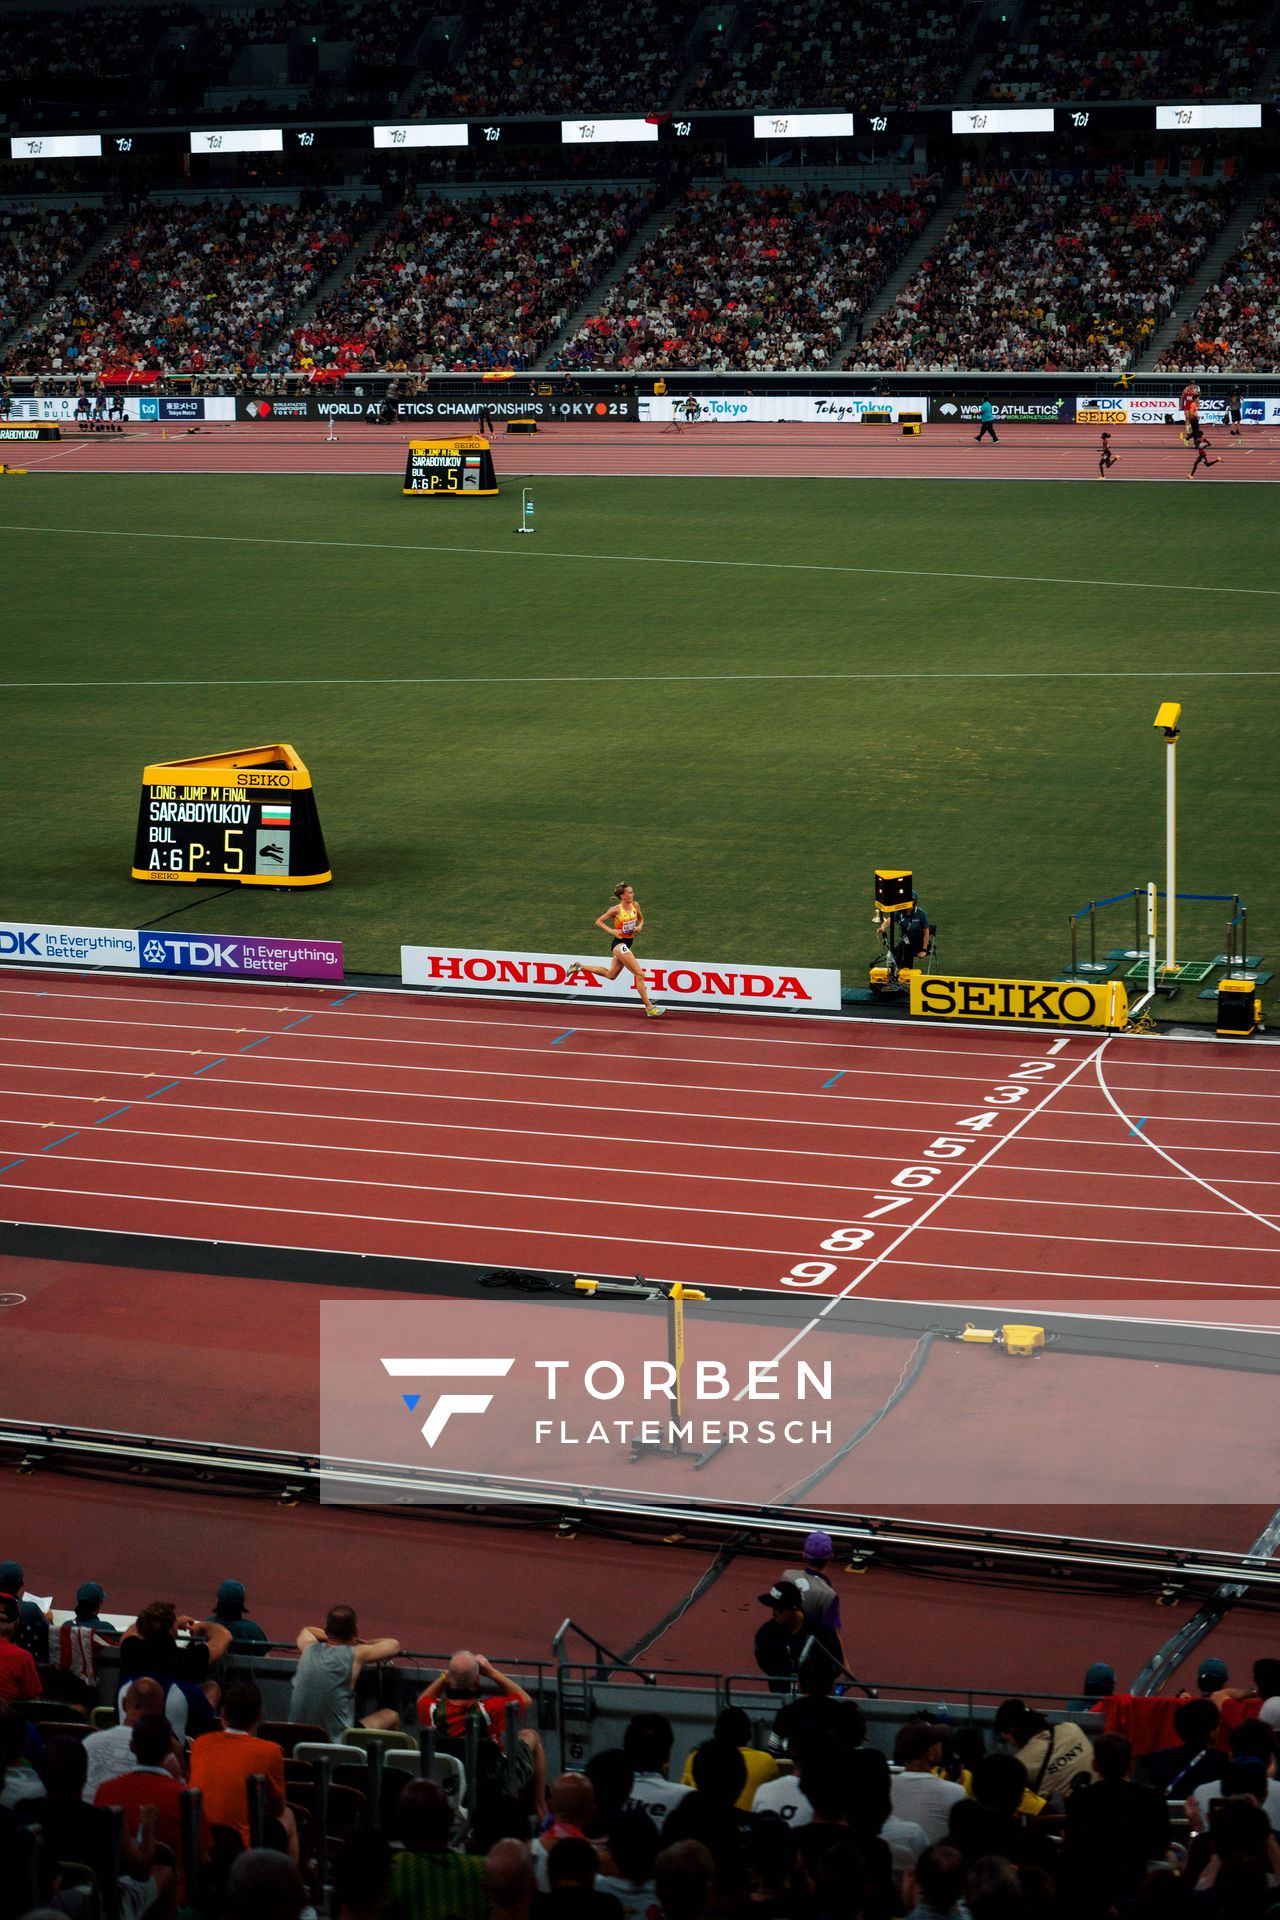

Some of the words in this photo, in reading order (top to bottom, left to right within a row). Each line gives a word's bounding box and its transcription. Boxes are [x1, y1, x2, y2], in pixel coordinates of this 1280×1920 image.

[317, 403, 362, 415] WORLD
[366, 403, 434, 415] ATETICS
[1001, 405, 1058, 414] ATHLETICS
[1078, 412, 1126, 422] SEIKO
[447, 469, 457, 489] 5
[237, 774, 290, 787] SEIKO
[150, 786, 176, 800] LONG
[180, 786, 207, 801] JUMP
[211, 787, 219, 801] M
[223, 788, 249, 802] FINAL
[149, 827, 176, 843] BUL
[149, 848, 182, 870] A:6
[189, 843, 211, 871] P:
[223, 830, 244, 872] 5
[46, 934, 57, 945] In
[60, 935, 136, 953] Everything,
[47, 946, 88, 959] Better
[165, 941, 240, 968] TDK
[243, 945, 254, 957] In
[258, 947, 338, 964] Everything,
[243, 958, 288, 972] Better
[427, 956, 603, 989] HONDA
[630, 968, 813, 1000] HONDA
[921, 980, 1096, 1022] SEIKO
[1046, 1039, 1070, 1055] 1
[1008, 1062, 1056, 1080] 2
[984, 1086, 1029, 1104] 3
[955, 1112, 999, 1132] 4
[923, 1138, 975, 1158] 5
[891, 1166, 941, 1188] 6
[863, 1196, 914, 1219] 7
[820, 1228, 874, 1251] 8
[780, 1262, 837, 1287] 9
[1047, 1743, 1083, 1775] SONY
